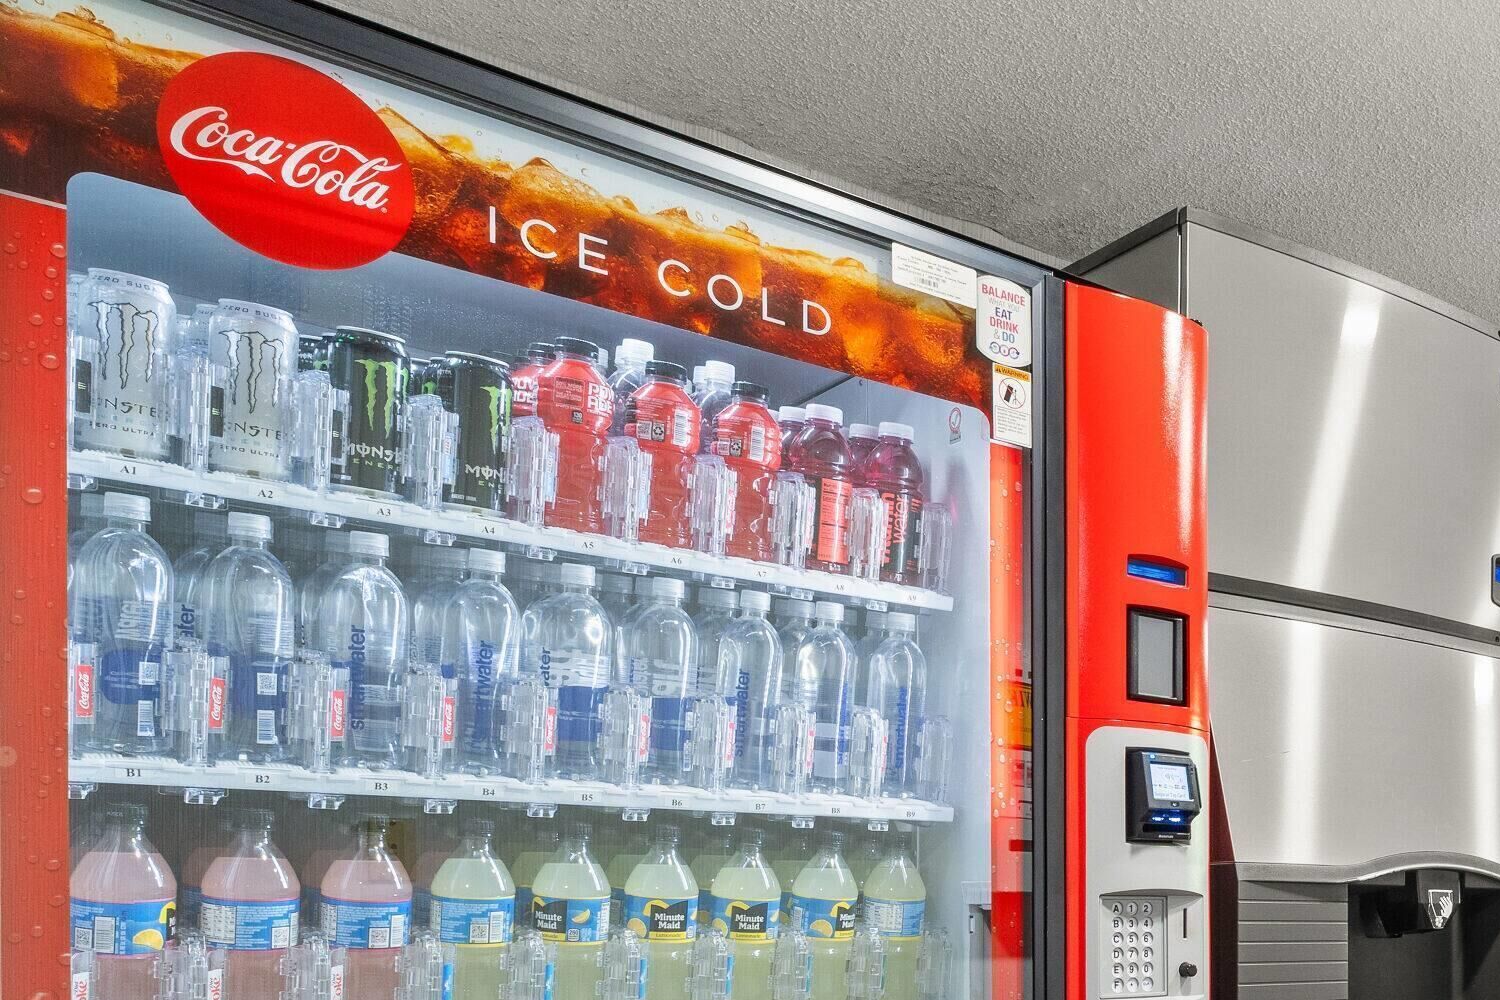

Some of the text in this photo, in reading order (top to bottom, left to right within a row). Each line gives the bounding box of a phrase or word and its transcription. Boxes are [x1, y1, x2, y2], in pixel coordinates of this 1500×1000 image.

[170, 106, 402, 209] Coca-Cola
[489, 206, 608, 276] ICE
[657, 259, 832, 336] COLD
[981, 283, 1025, 307] BALANCE
[995, 307, 1012, 321] EAT
[990, 316, 1019, 334] DRINK
[993, 330, 1015, 344] & DO
[1001, 368, 1029, 381] WARNING
[120, 465, 136, 475] A1
[257, 489, 273, 498] A2
[377, 508, 391, 517] A3
[481, 525, 495, 534] A4
[581, 541, 594, 549] A5
[671, 556, 682, 565] A6
[127, 768, 141, 777] B1
[255, 774, 270, 783] B2
[375, 782, 388, 791] B3
[482, 788, 495, 796] B4
[581, 793, 593, 801] B5
[672, 799, 682, 807] B6
[755, 803, 766, 811] B7
[1113, 905, 1119, 913] A
[535, 910, 562, 921] Minute
[654, 913, 685, 922] Minute
[735, 913, 764, 923] Minute
[537, 920, 557, 929] Maid
[658, 921, 680, 929] Maid
[738, 922, 760, 930] Maid
[1113, 920, 1119, 928] B
[1113, 935, 1119, 943] C
[1129, 935, 1134, 943] 5
[1113, 950, 1119, 958] D
[1128, 950, 1133, 958] 7
[1114, 965, 1119, 973] E
[1129, 965, 1134, 973] 9
[1114, 981, 1119, 989] F
